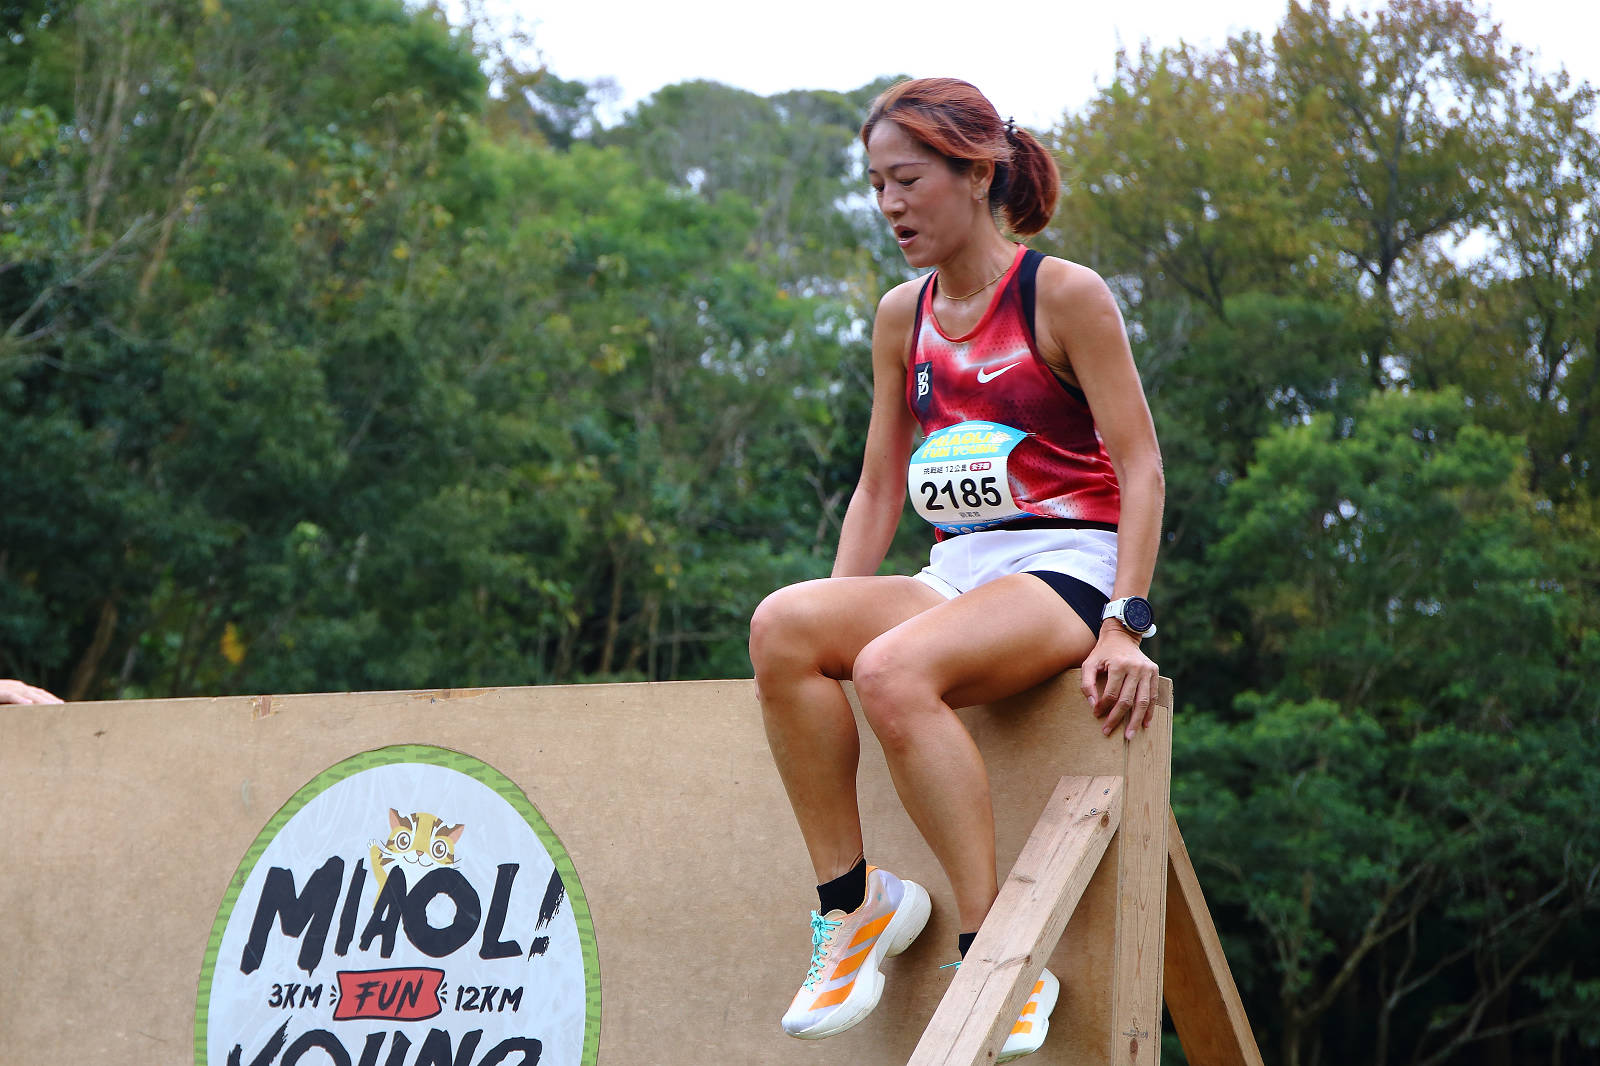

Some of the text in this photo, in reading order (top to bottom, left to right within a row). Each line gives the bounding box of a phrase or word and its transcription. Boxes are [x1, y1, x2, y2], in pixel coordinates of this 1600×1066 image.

[920, 476, 1002, 511] 2185
[268, 976, 524, 1016] 3KM FUN 12KM
